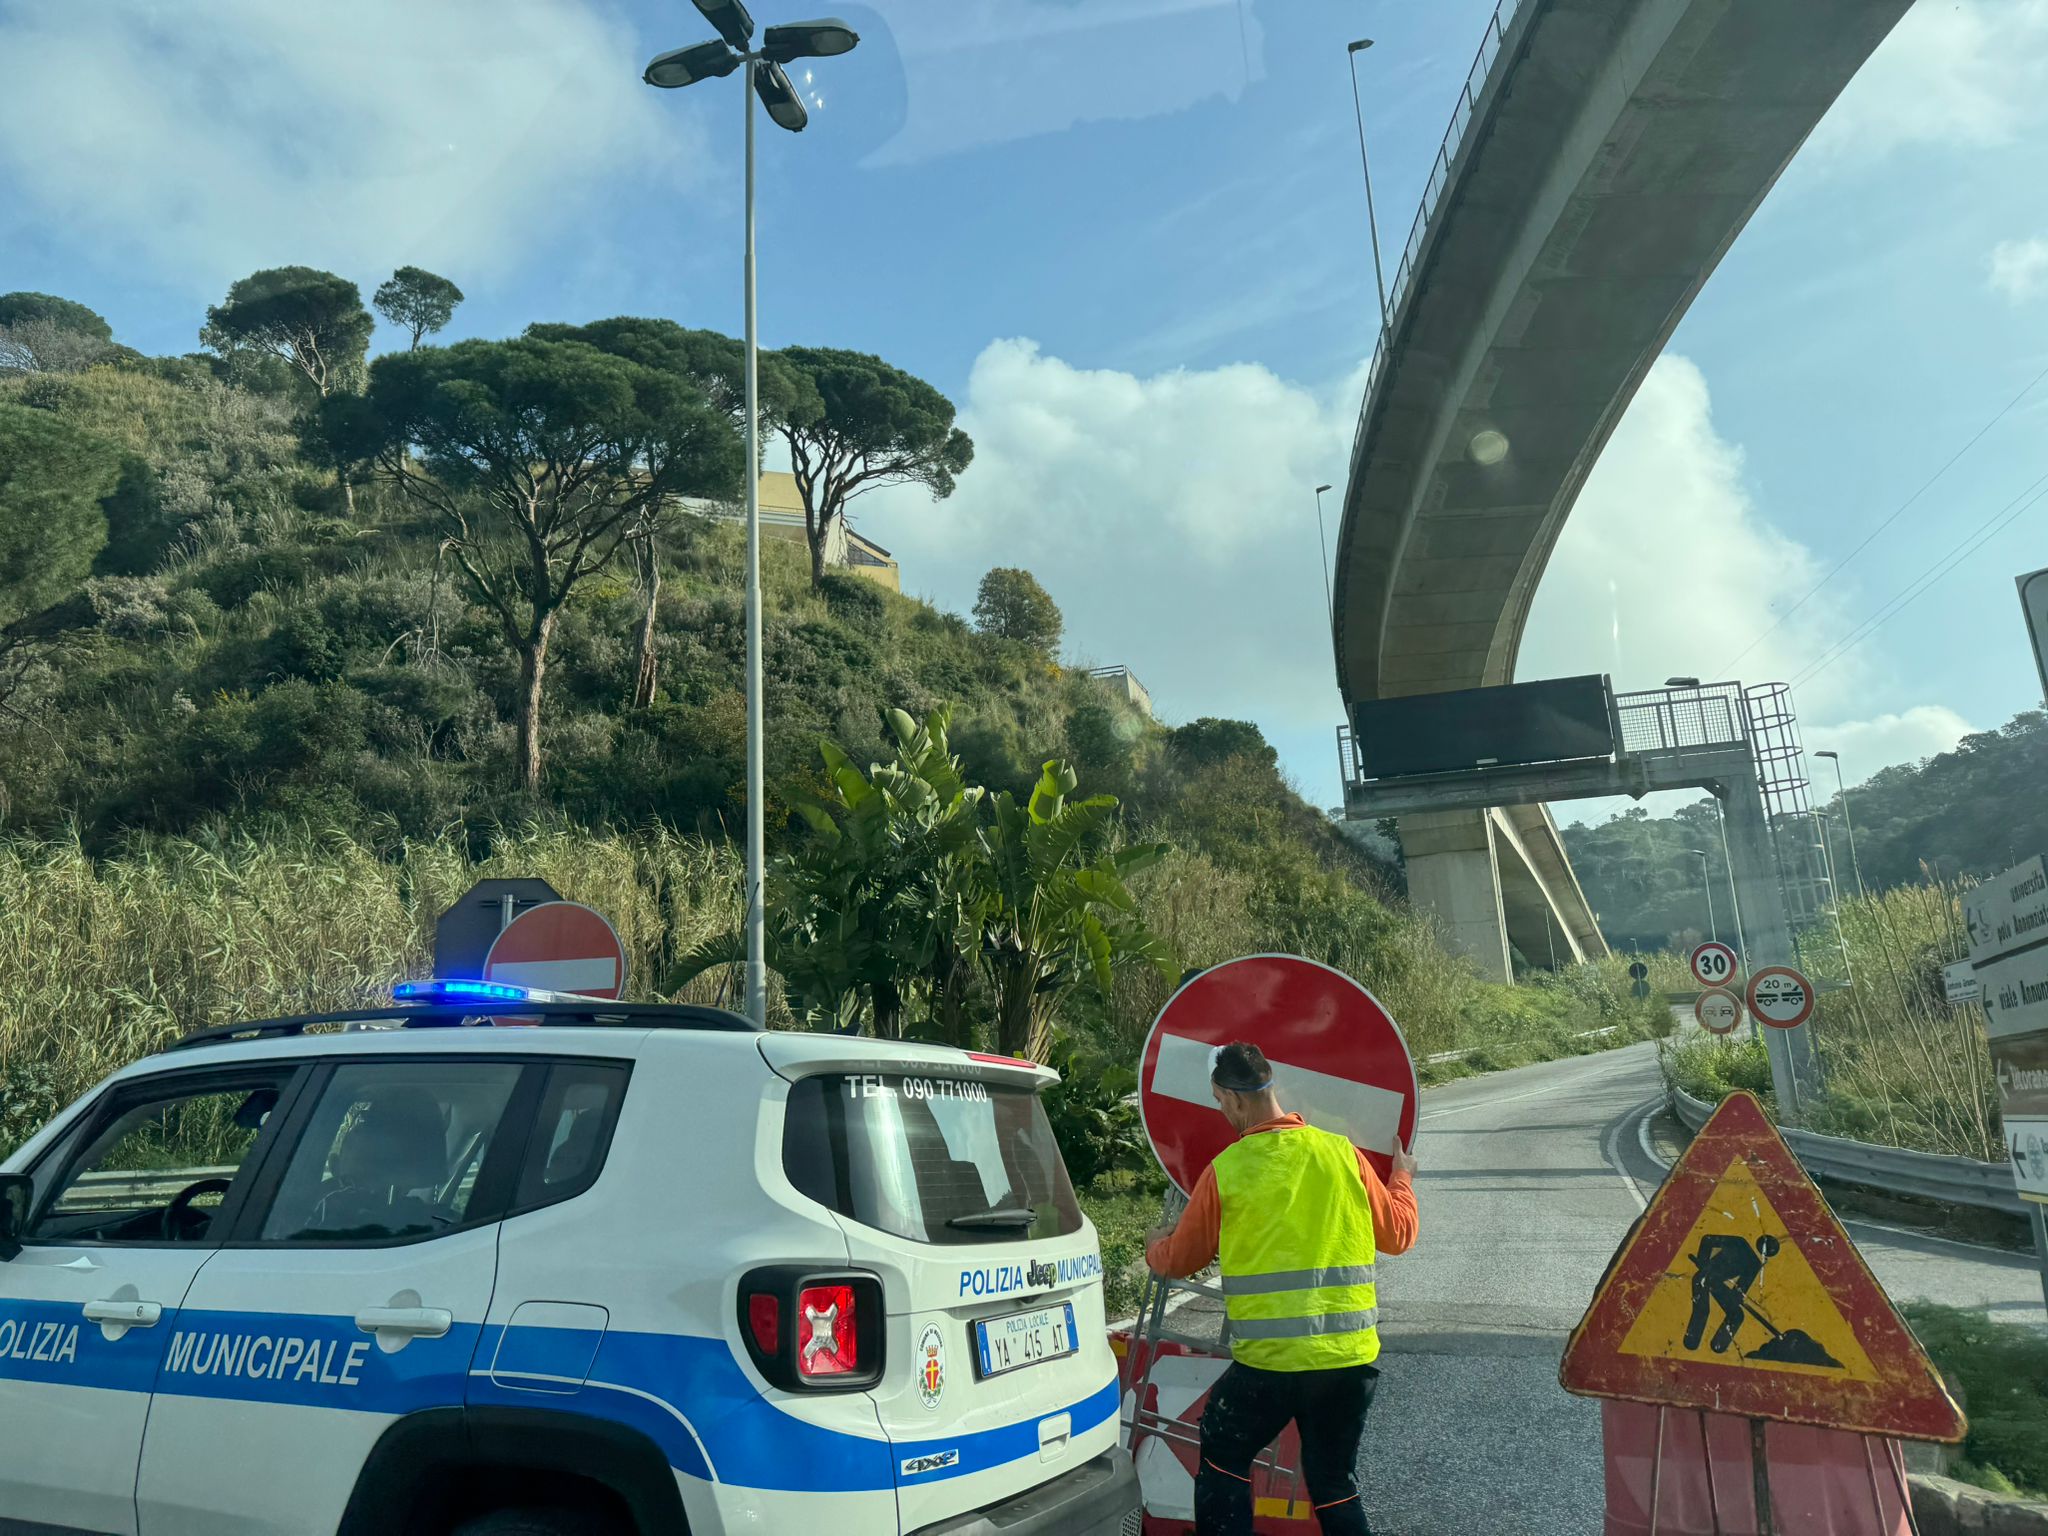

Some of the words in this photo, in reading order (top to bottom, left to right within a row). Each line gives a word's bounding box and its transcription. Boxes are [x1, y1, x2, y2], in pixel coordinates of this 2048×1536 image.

[1700, 953, 1726, 976] 30
[1764, 979, 1780, 989] 20
[902, 1077, 934, 1100] 090
[936, 1079, 987, 1103] 771000
[959, 1266, 1023, 1297] POLIZIA
[1026, 1259, 1057, 1289] Jeep
[1006, 1318, 1027, 1333] POLIZIA
[165, 1331, 370, 1385] MUNICIPALE
[995, 1337, 1011, 1367] YA
[1024, 1329, 1043, 1360] 415
[1052, 1324, 1064, 1352] AT
